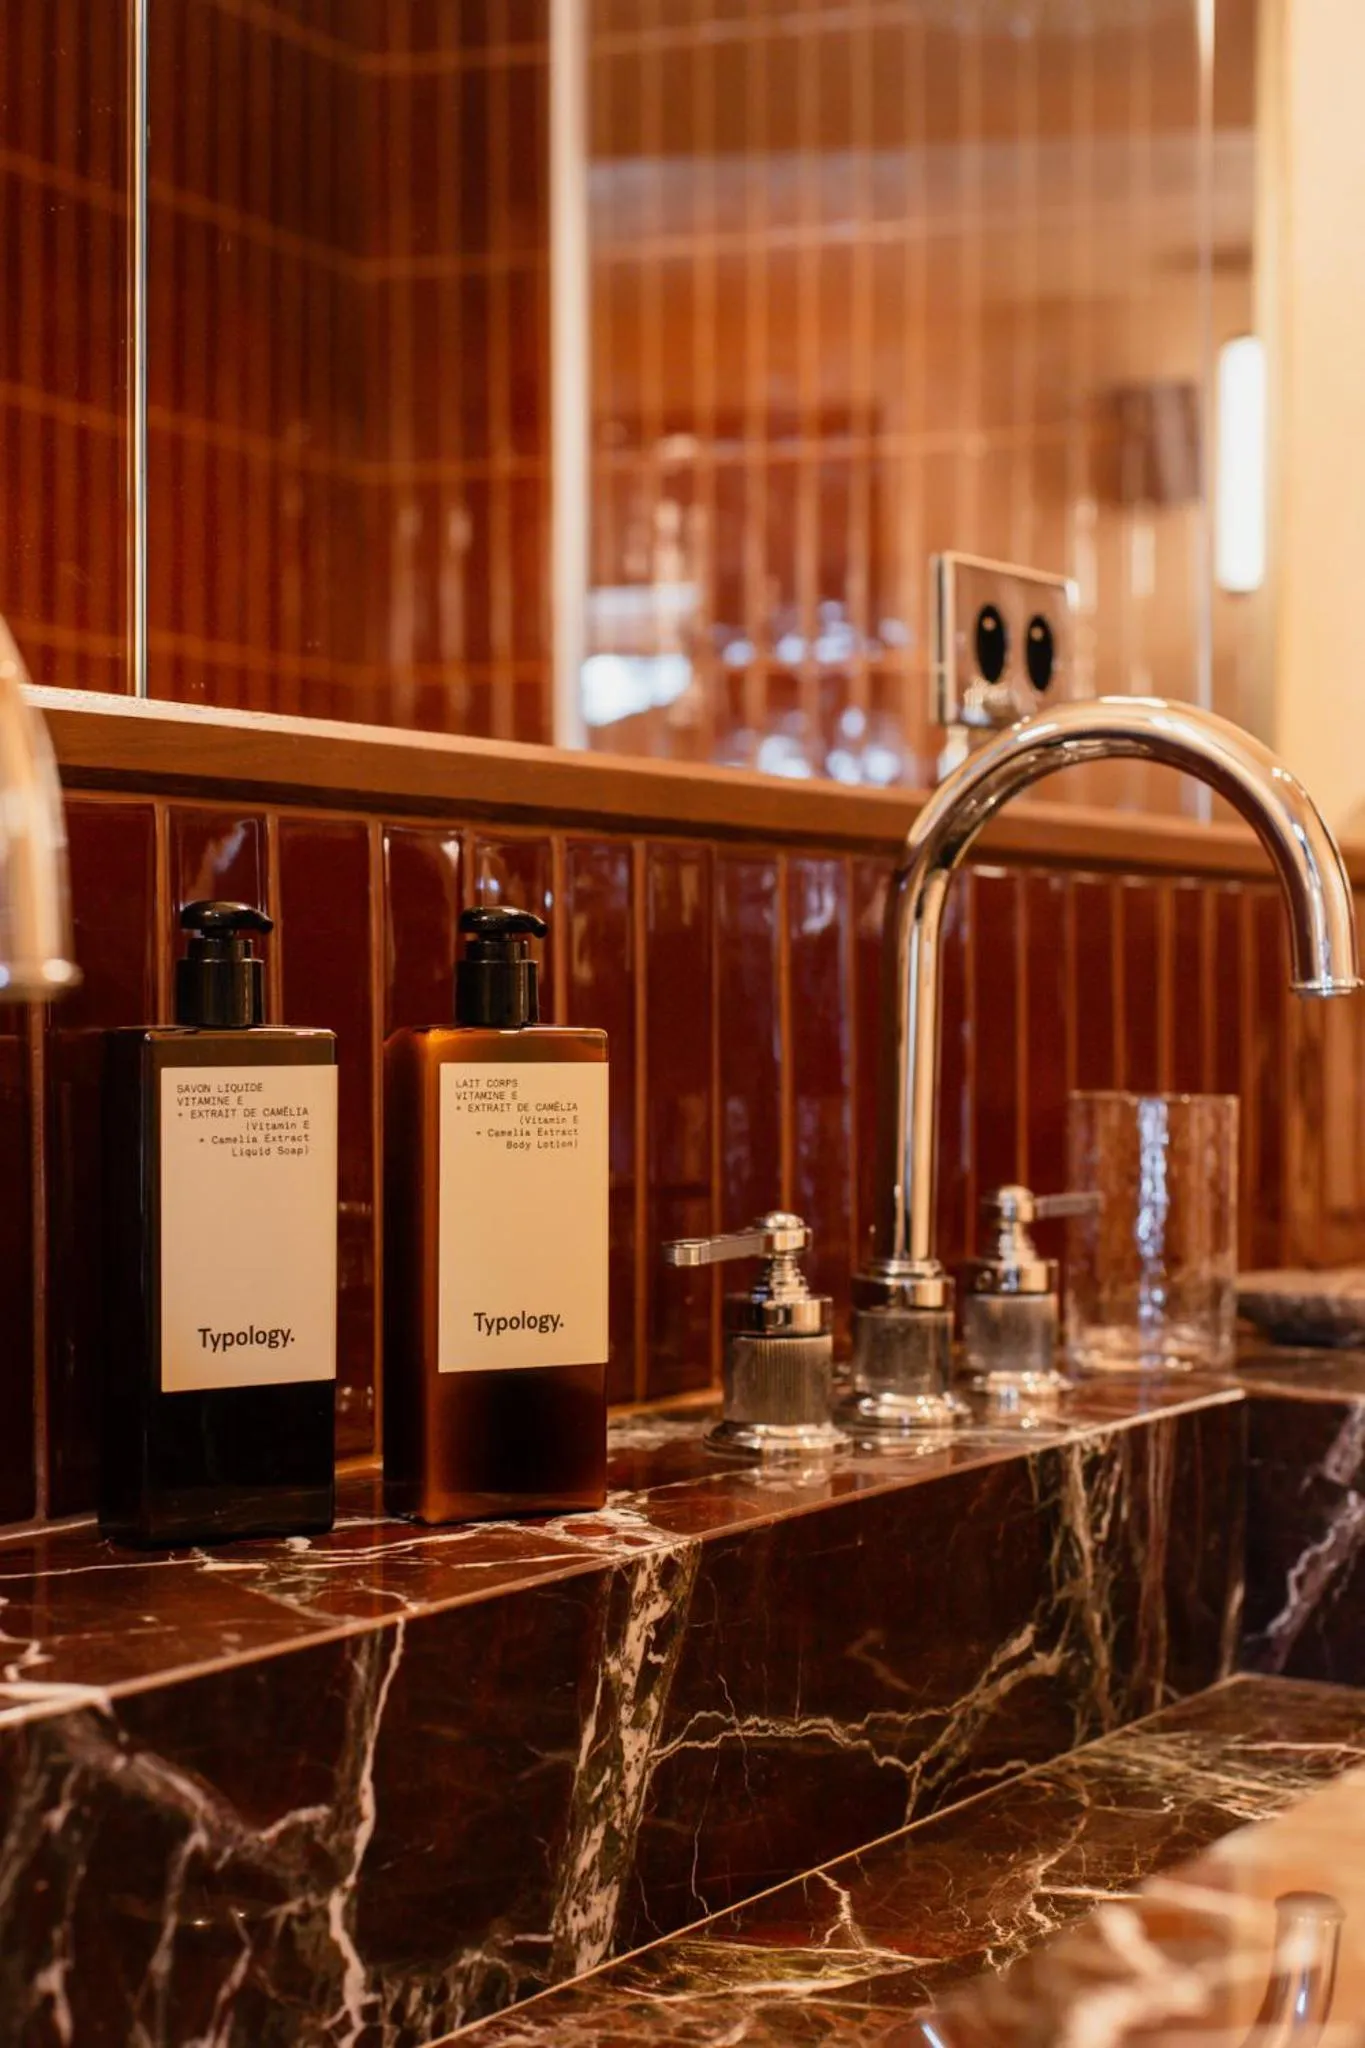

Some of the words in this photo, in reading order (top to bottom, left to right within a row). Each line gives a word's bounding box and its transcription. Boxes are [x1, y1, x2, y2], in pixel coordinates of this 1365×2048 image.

[176, 1084, 211, 1093] SAVON
[217, 1082, 263, 1093] LIQUIDE
[455, 1079, 480, 1088] LAIT
[487, 1078, 518, 1088] CORPS
[177, 1096, 230, 1106] VITAMINE
[455, 1091, 506, 1101] VITAMINE
[190, 1108, 237, 1119] EXTRAIT
[243, 1108, 256, 1118] DE
[262, 1106, 309, 1117] CAMÉLIA
[467, 1103, 511, 1113] EXTRAIT
[517, 1103, 529, 1112] DE
[535, 1101, 578, 1112] CAMÉLIA
[487, 1128, 531, 1138] Camelia
[537, 1127, 579, 1136] Extract
[211, 1134, 258, 1145] Camelia
[264, 1133, 310, 1143] Extract
[506, 1140, 531, 1150] Body
[231, 1146, 271, 1157] Liquid
[473, 1310, 565, 1336] Typology.
[197, 1325, 295, 1352] Typology.
